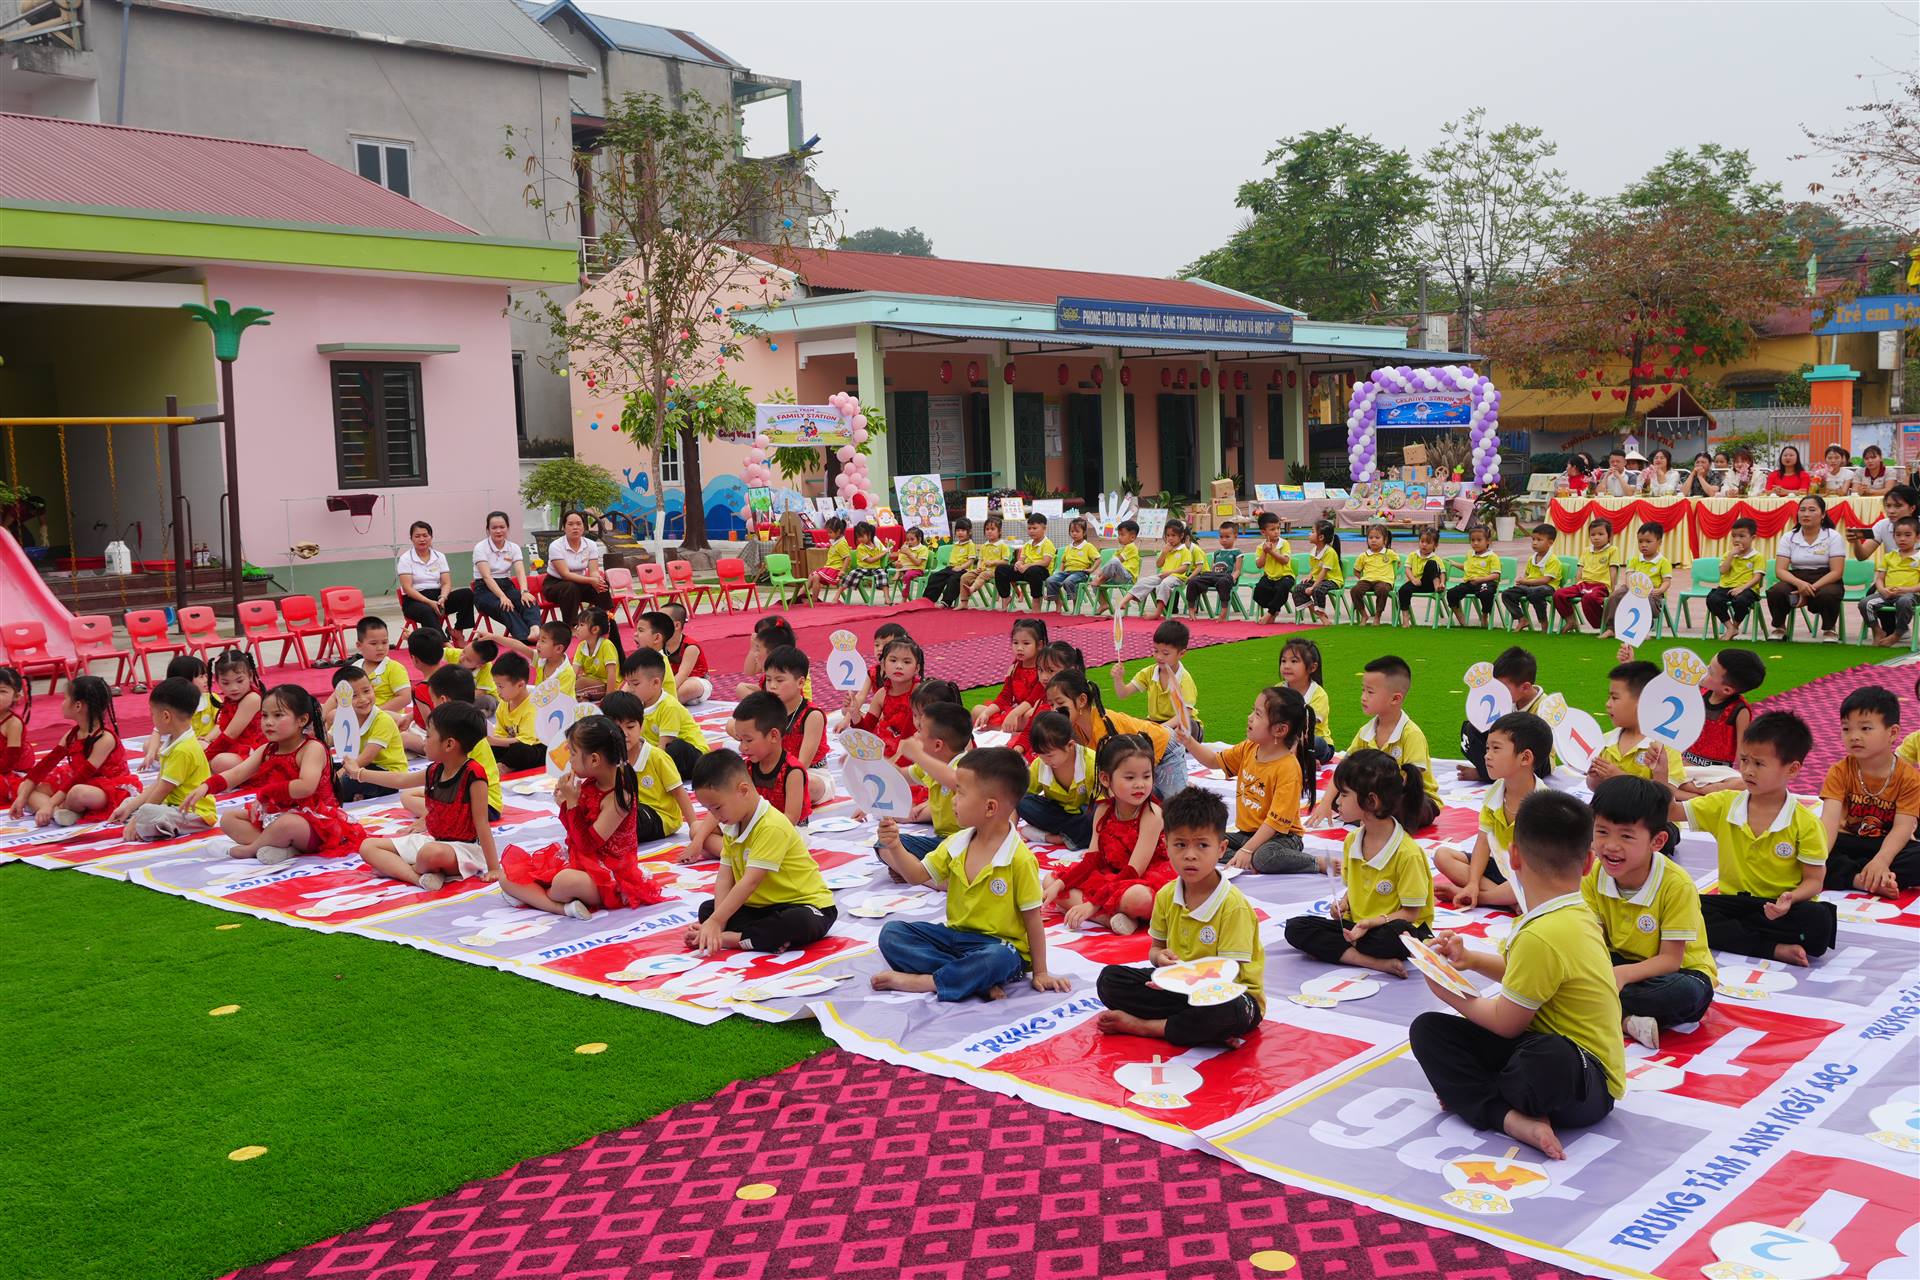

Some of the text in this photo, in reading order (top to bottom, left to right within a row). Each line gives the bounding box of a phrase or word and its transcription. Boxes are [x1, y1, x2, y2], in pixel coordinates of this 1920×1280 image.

[1083, 310, 1101, 326] PHONG
[1117, 312, 1126, 327] THI
[1187, 317, 1202, 331] TRONG
[1836, 304, 1862, 323] Trẻ
[1866, 308, 1889, 321] em
[1396, 396, 1425, 404] CREATIVE
[776, 412, 837, 421] FAMILY STATION
[1622, 607, 1641, 639] 2
[839, 659, 856, 686] 2
[1479, 694, 1501, 725] 2
[1652, 695, 1685, 741] 2
[343, 719, 353, 753] 2
[1569, 727, 1595, 760] 1
[862, 773, 894, 811] 2
[499, 924, 533, 936] 1
[783, 978, 825, 990] 1
[1327, 980, 1358, 993] 1
[964, 1016, 1057, 1055] TRUNG
[1858, 1005, 1920, 1042] TRUNG
[1144, 1066, 1171, 1086] 1
[1608, 1062, 1860, 1251] TRUNG TÂM ANH NGỮ ABC
[1750, 1230, 1809, 1262] 2
